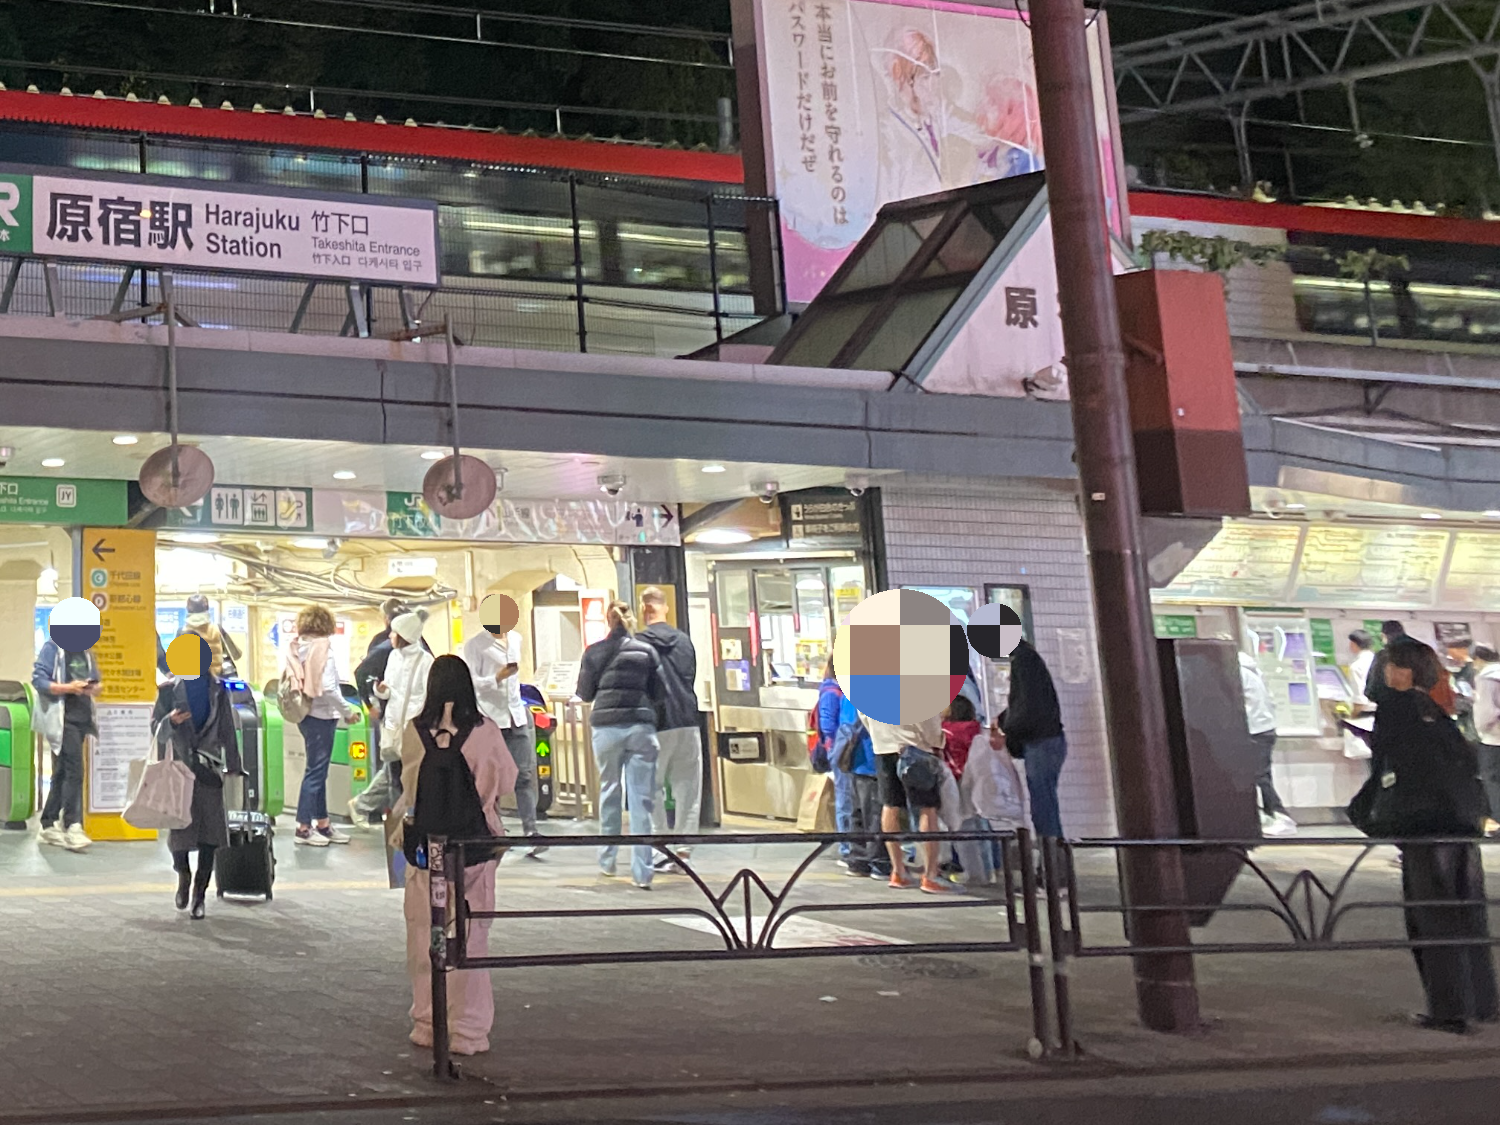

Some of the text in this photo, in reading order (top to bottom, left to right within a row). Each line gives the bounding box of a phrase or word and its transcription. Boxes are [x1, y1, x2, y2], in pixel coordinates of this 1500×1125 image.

[814, 3, 849, 225] 本当にお前を守れるのは
[46, 191, 194, 251] 原宿駅
[204, 202, 300, 234] Harajuku
[311, 210, 369, 236] 竹下口
[205, 232, 282, 260] Station
[311, 236, 421, 257] Takeshita Entrance
[312, 252, 351, 266] 竹下入口
[1005, 286, 1039, 329] 原
